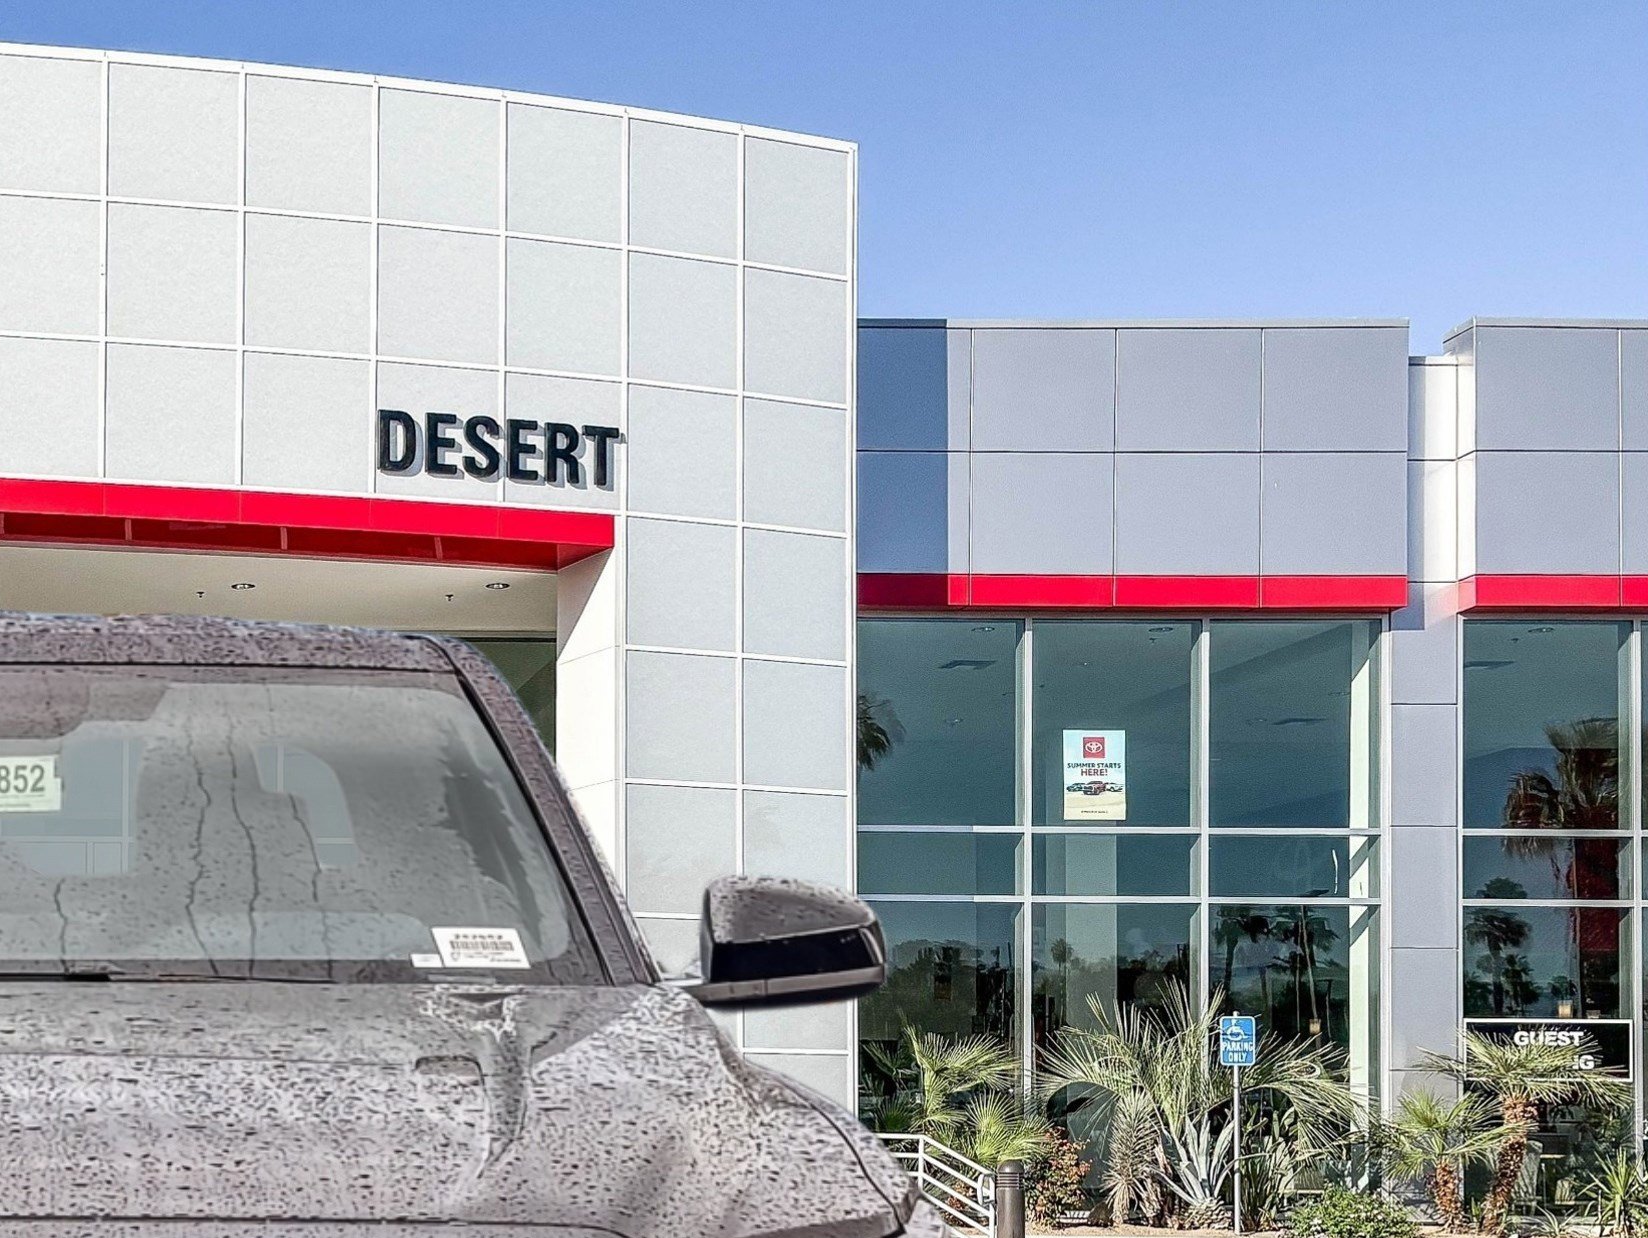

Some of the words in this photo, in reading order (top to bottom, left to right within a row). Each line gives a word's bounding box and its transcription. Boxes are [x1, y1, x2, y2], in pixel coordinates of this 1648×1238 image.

[377, 409, 620, 486] DESERT
[1080, 768, 1109, 777] HERE!
[1513, 1030, 1585, 1047] GUEST
[1222, 1041, 1254, 1052] PARKING
[1228, 1051, 1248, 1063] ONLY
